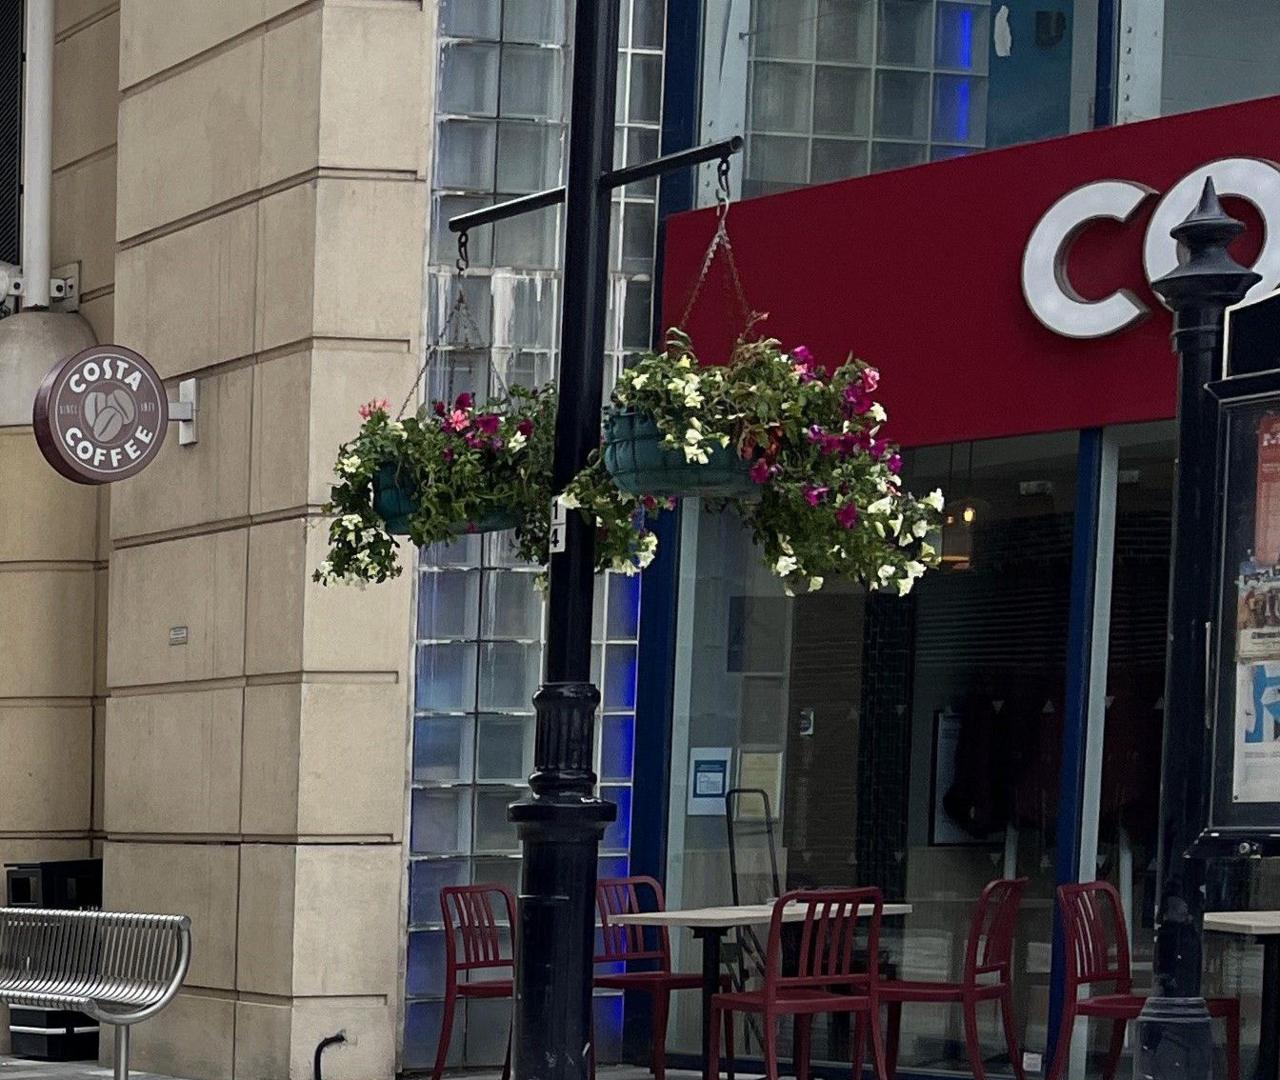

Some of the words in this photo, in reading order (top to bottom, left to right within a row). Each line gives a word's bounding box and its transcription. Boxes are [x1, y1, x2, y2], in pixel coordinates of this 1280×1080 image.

[69, 359, 142, 393] COSTA
[65, 426, 153, 467] COFFEE
[552, 500, 558, 520] 1
[551, 528, 560, 548] 4
